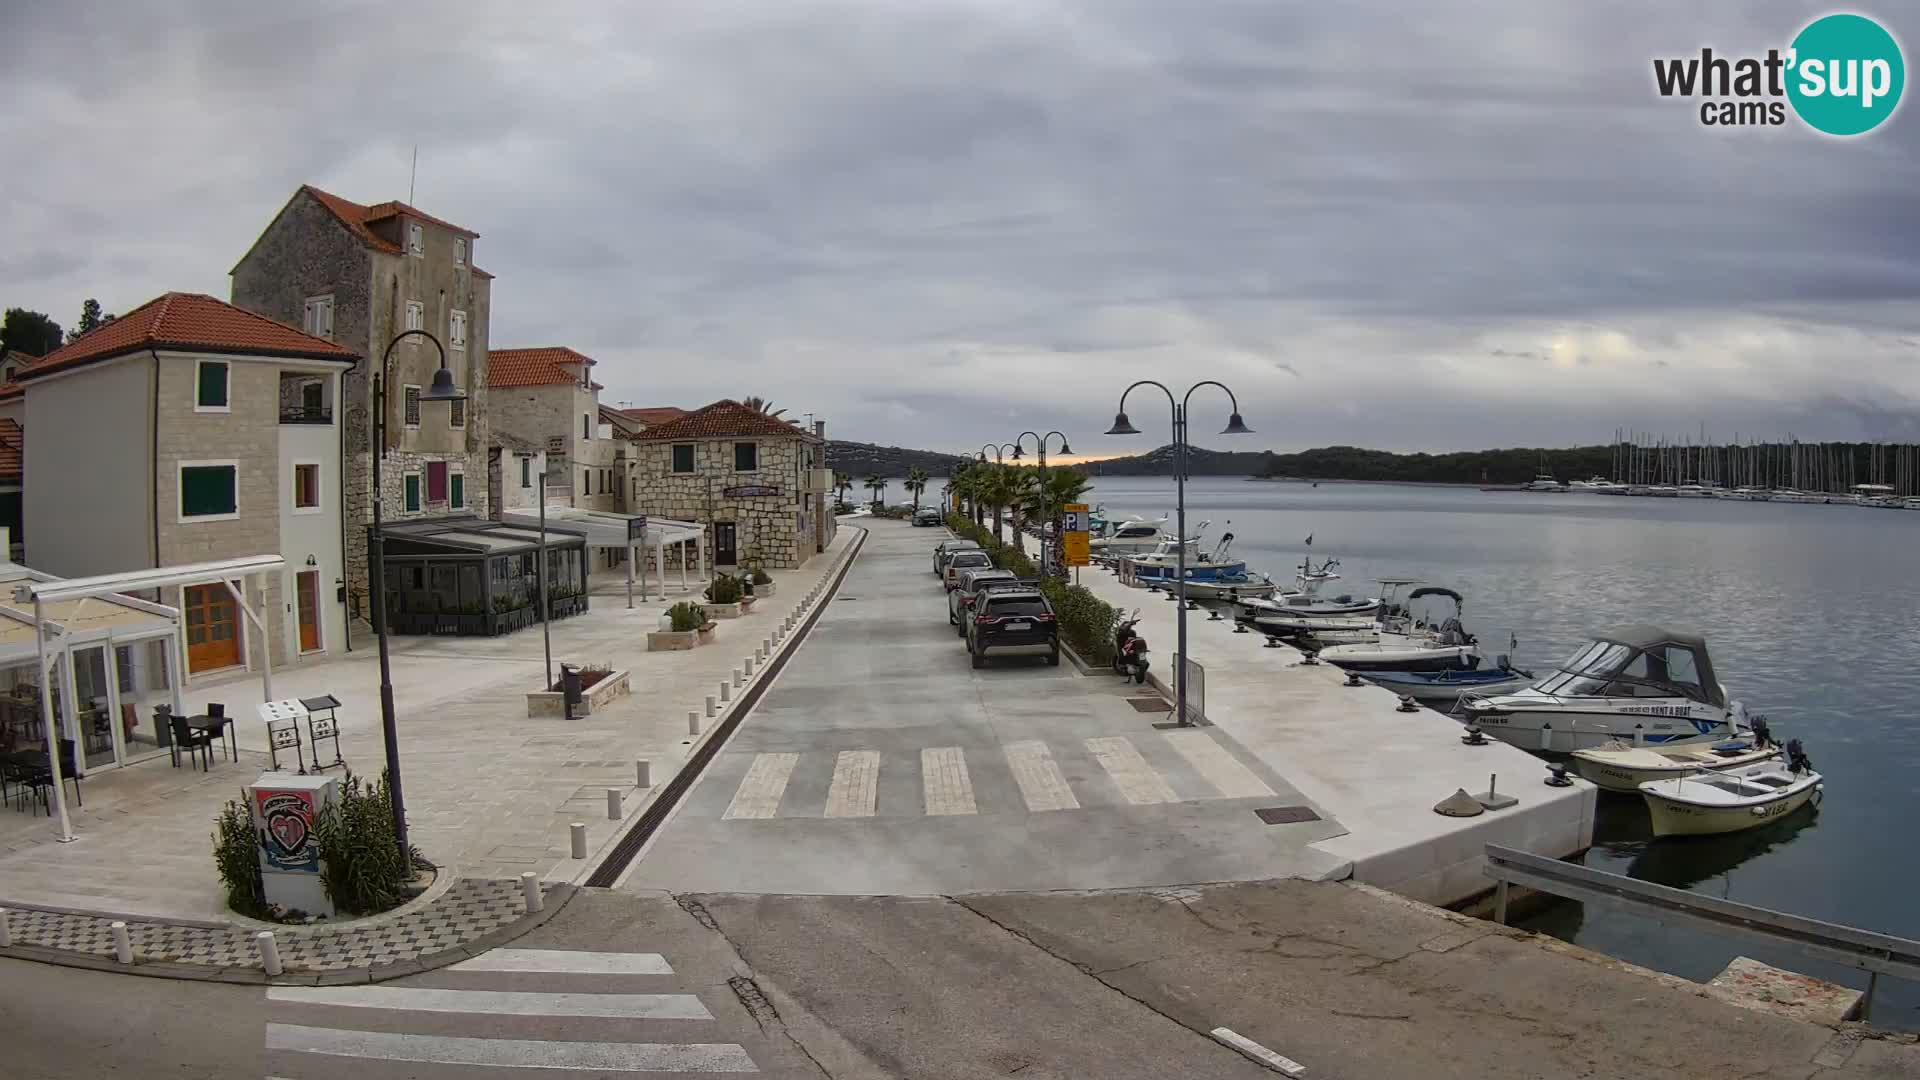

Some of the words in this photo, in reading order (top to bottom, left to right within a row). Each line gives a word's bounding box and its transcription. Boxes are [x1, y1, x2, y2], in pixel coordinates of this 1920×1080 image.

[1066, 513, 1077, 530] P
[1651, 706, 1668, 716] RENT
[1669, 706, 1674, 716] A
[1675, 706, 1692, 717] BOAT
